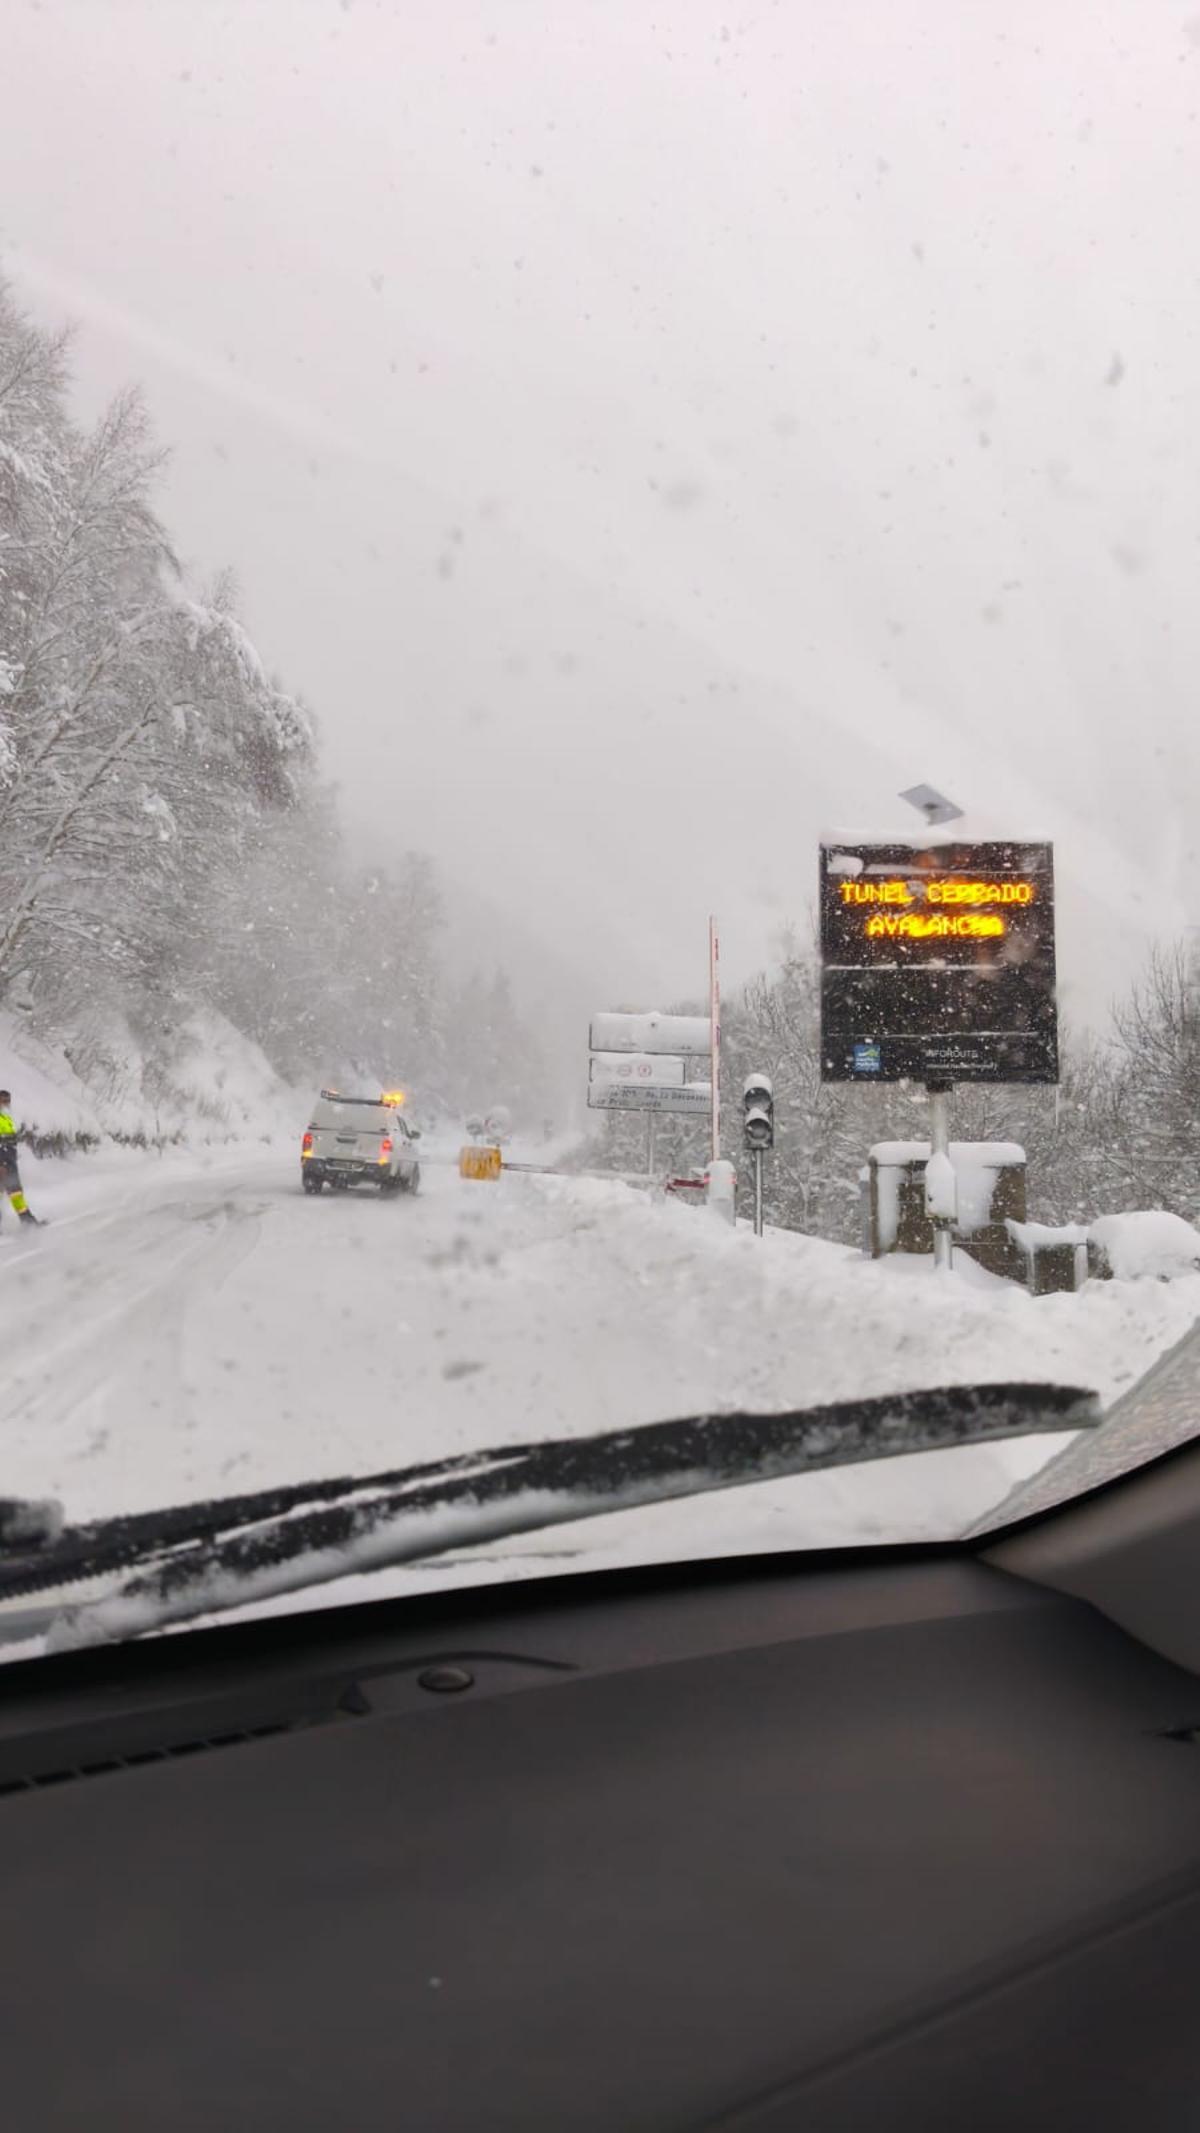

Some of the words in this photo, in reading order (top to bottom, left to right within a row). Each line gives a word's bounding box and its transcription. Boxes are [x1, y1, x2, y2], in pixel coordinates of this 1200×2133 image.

[840, 882, 914, 903] TUNEL
[927, 883, 1033, 903] CERRADO
[866, 915, 1005, 936] AVALANCA
